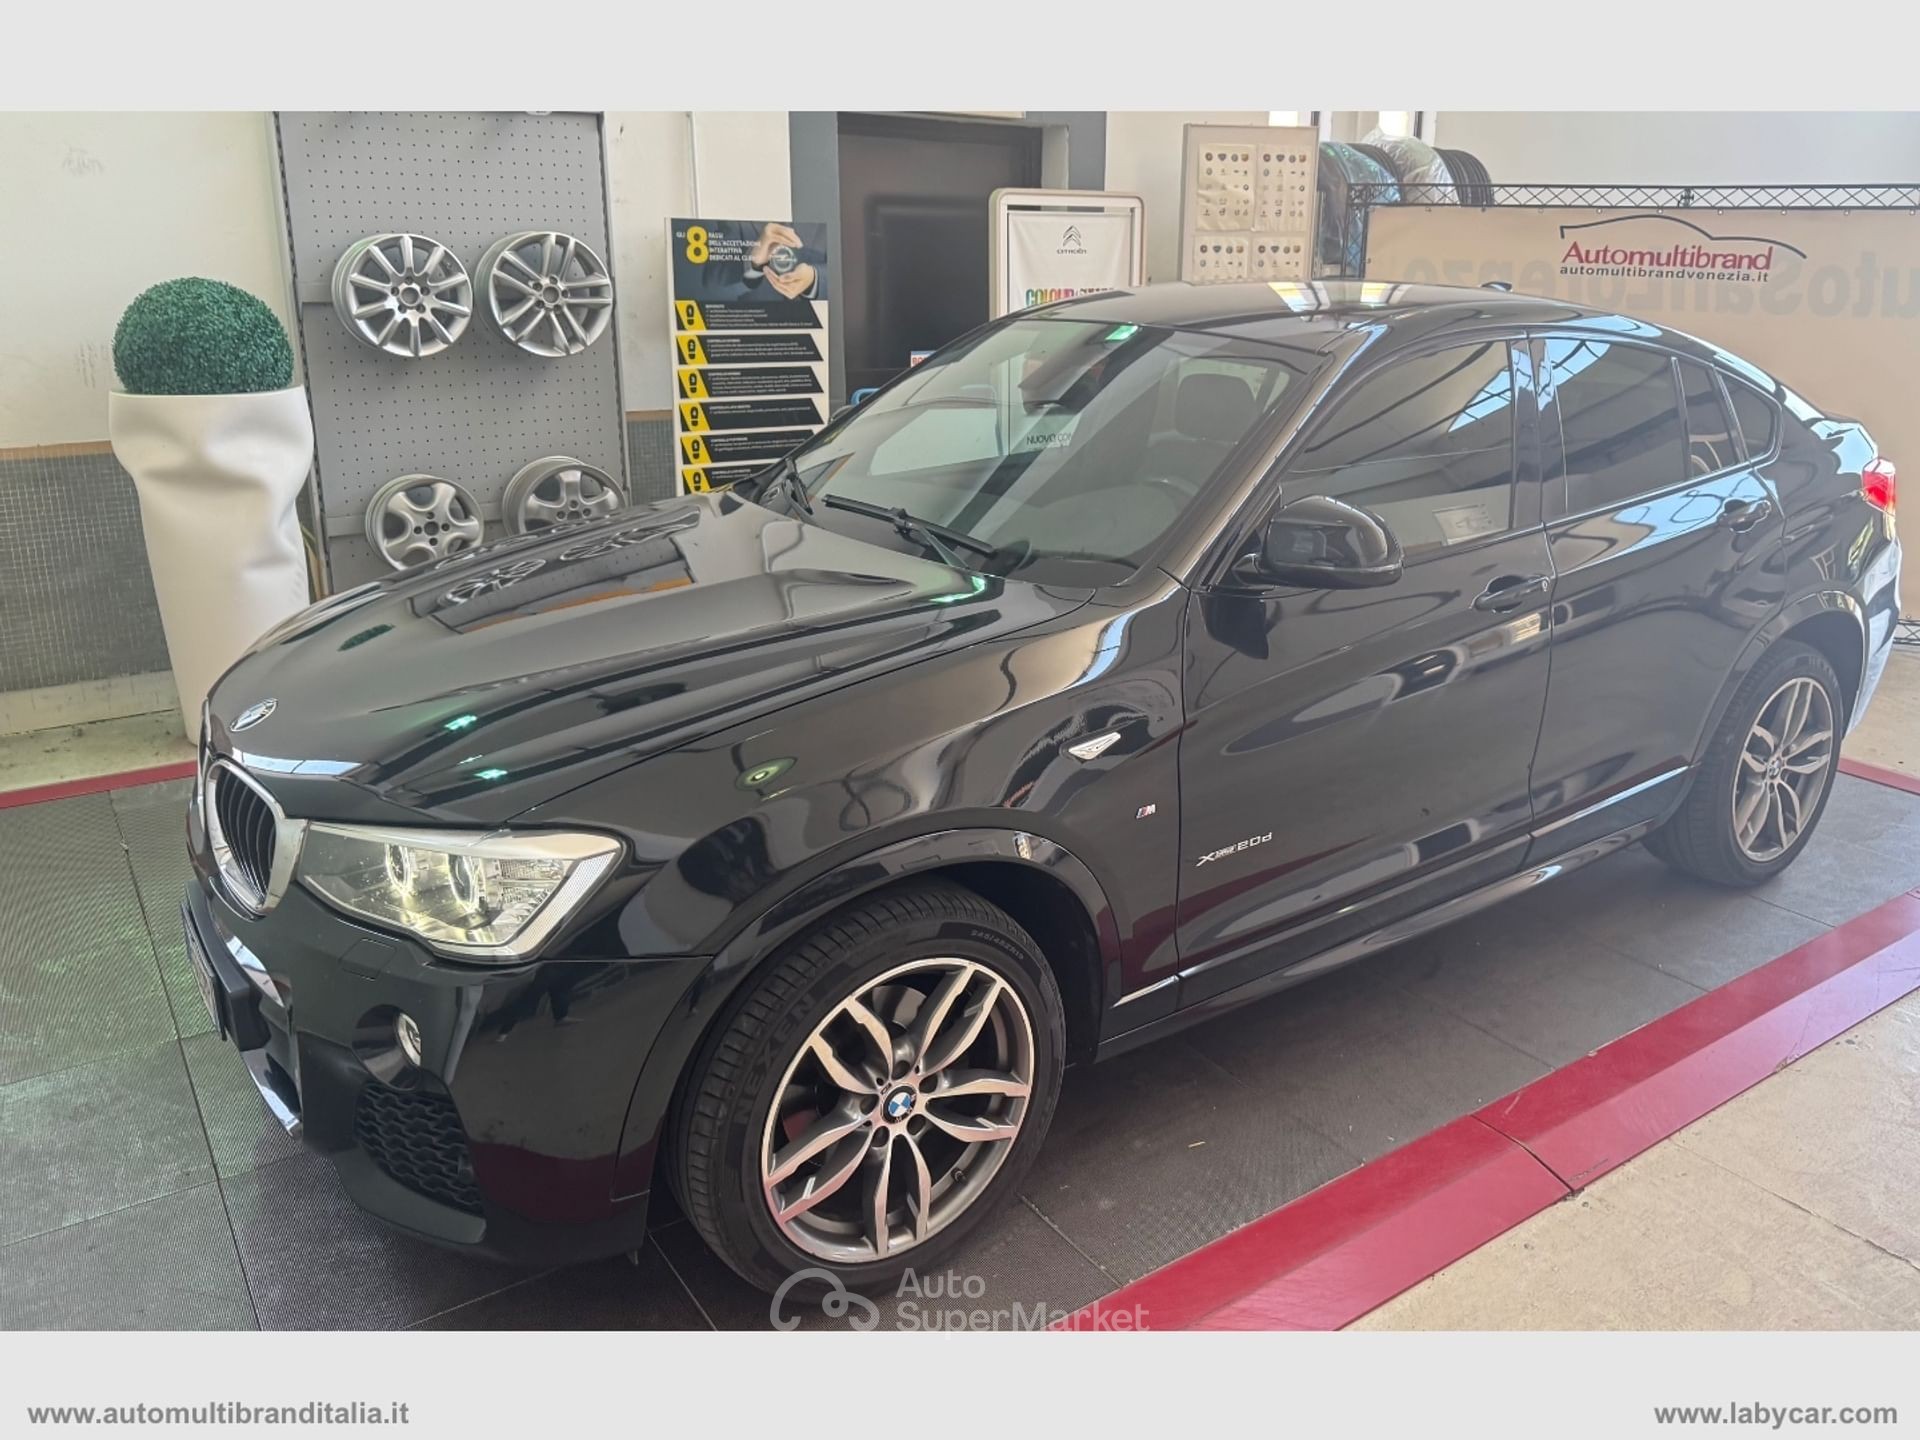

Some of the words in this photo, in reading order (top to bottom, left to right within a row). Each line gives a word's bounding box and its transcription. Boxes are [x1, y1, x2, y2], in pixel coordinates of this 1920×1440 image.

[686, 226, 709, 264] 8
[1562, 241, 1773, 270] Automultibrand
[1560, 265, 1769, 283] automultibrandvenezia.it
